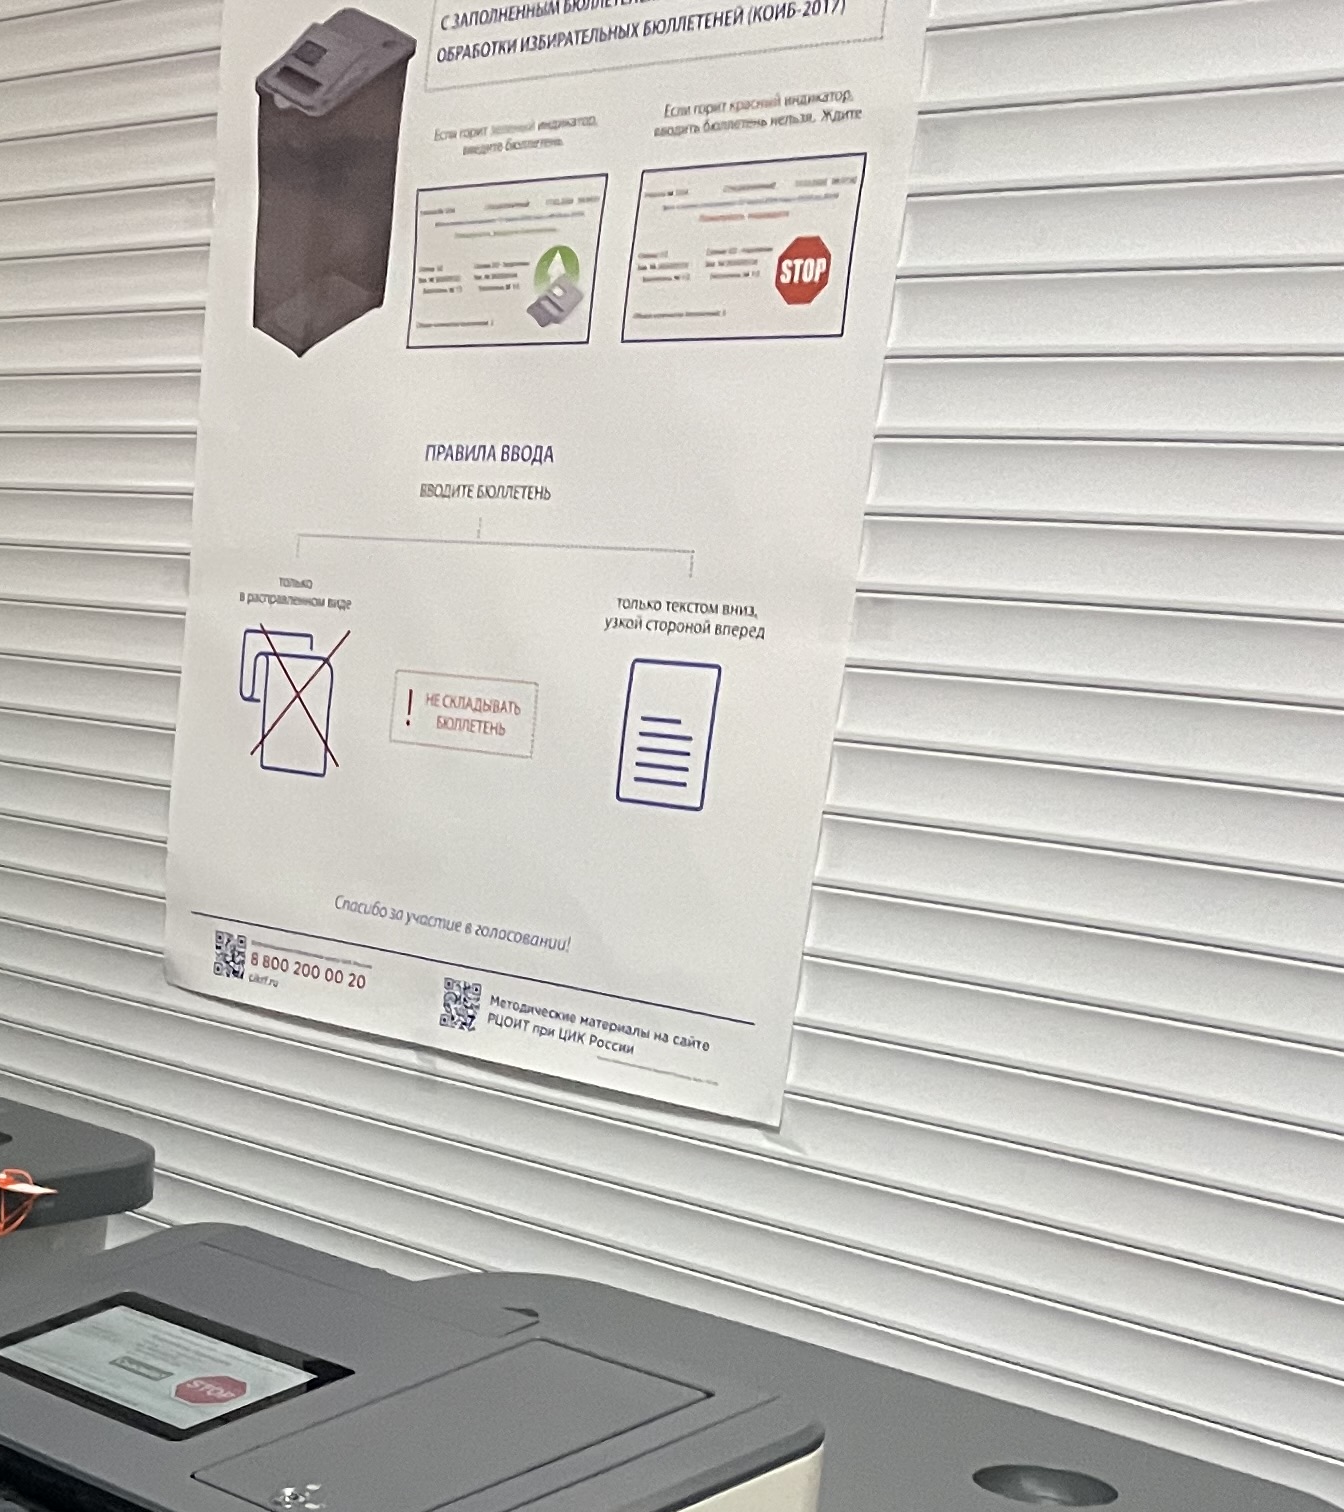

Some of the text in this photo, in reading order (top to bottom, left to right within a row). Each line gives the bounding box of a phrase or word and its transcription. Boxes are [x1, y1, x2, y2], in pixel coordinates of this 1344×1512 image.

[452, 1, 560, 30] ЗАПОЛНЕННЫМ
[436, 38, 518, 64] ОБРАБОТКИ
[520, 22, 640, 53] ИЗБИРАТЕЛЬНЫХ
[643, 6, 744, 37] БЮЛЛЕТЕНЕЙ
[779, 257, 828, 285] STOP
[425, 444, 554, 465] ПРАВИЛА ВВОДА
[420, 483, 552, 501] ВВОДИТЕ БЮЛЛЕТЕНЬ
[617, 597, 662, 613] только
[665, 600, 719, 616] текстом
[604, 614, 766, 641] узкой стороной вперед
[425, 691, 522, 717] НЕ СКЛАДЫВАТЬ
[436, 714, 507, 737] БЮЛЛЕТЕНЬ
[335, 894, 388, 919] Спасибо
[389, 907, 404, 921] за
[405, 911, 463, 934] участие
[474, 924, 571, 953] голосовании!
[250, 951, 259, 967] 8
[262, 954, 290, 973] 800
[293, 960, 321, 980] 200
[324, 967, 344, 985] 00
[347, 972, 367, 990] 20
[487, 1012, 635, 1056] РЦОИТ при ЦИК России
[489, 994, 711, 1052] Методические материалы на сайте
